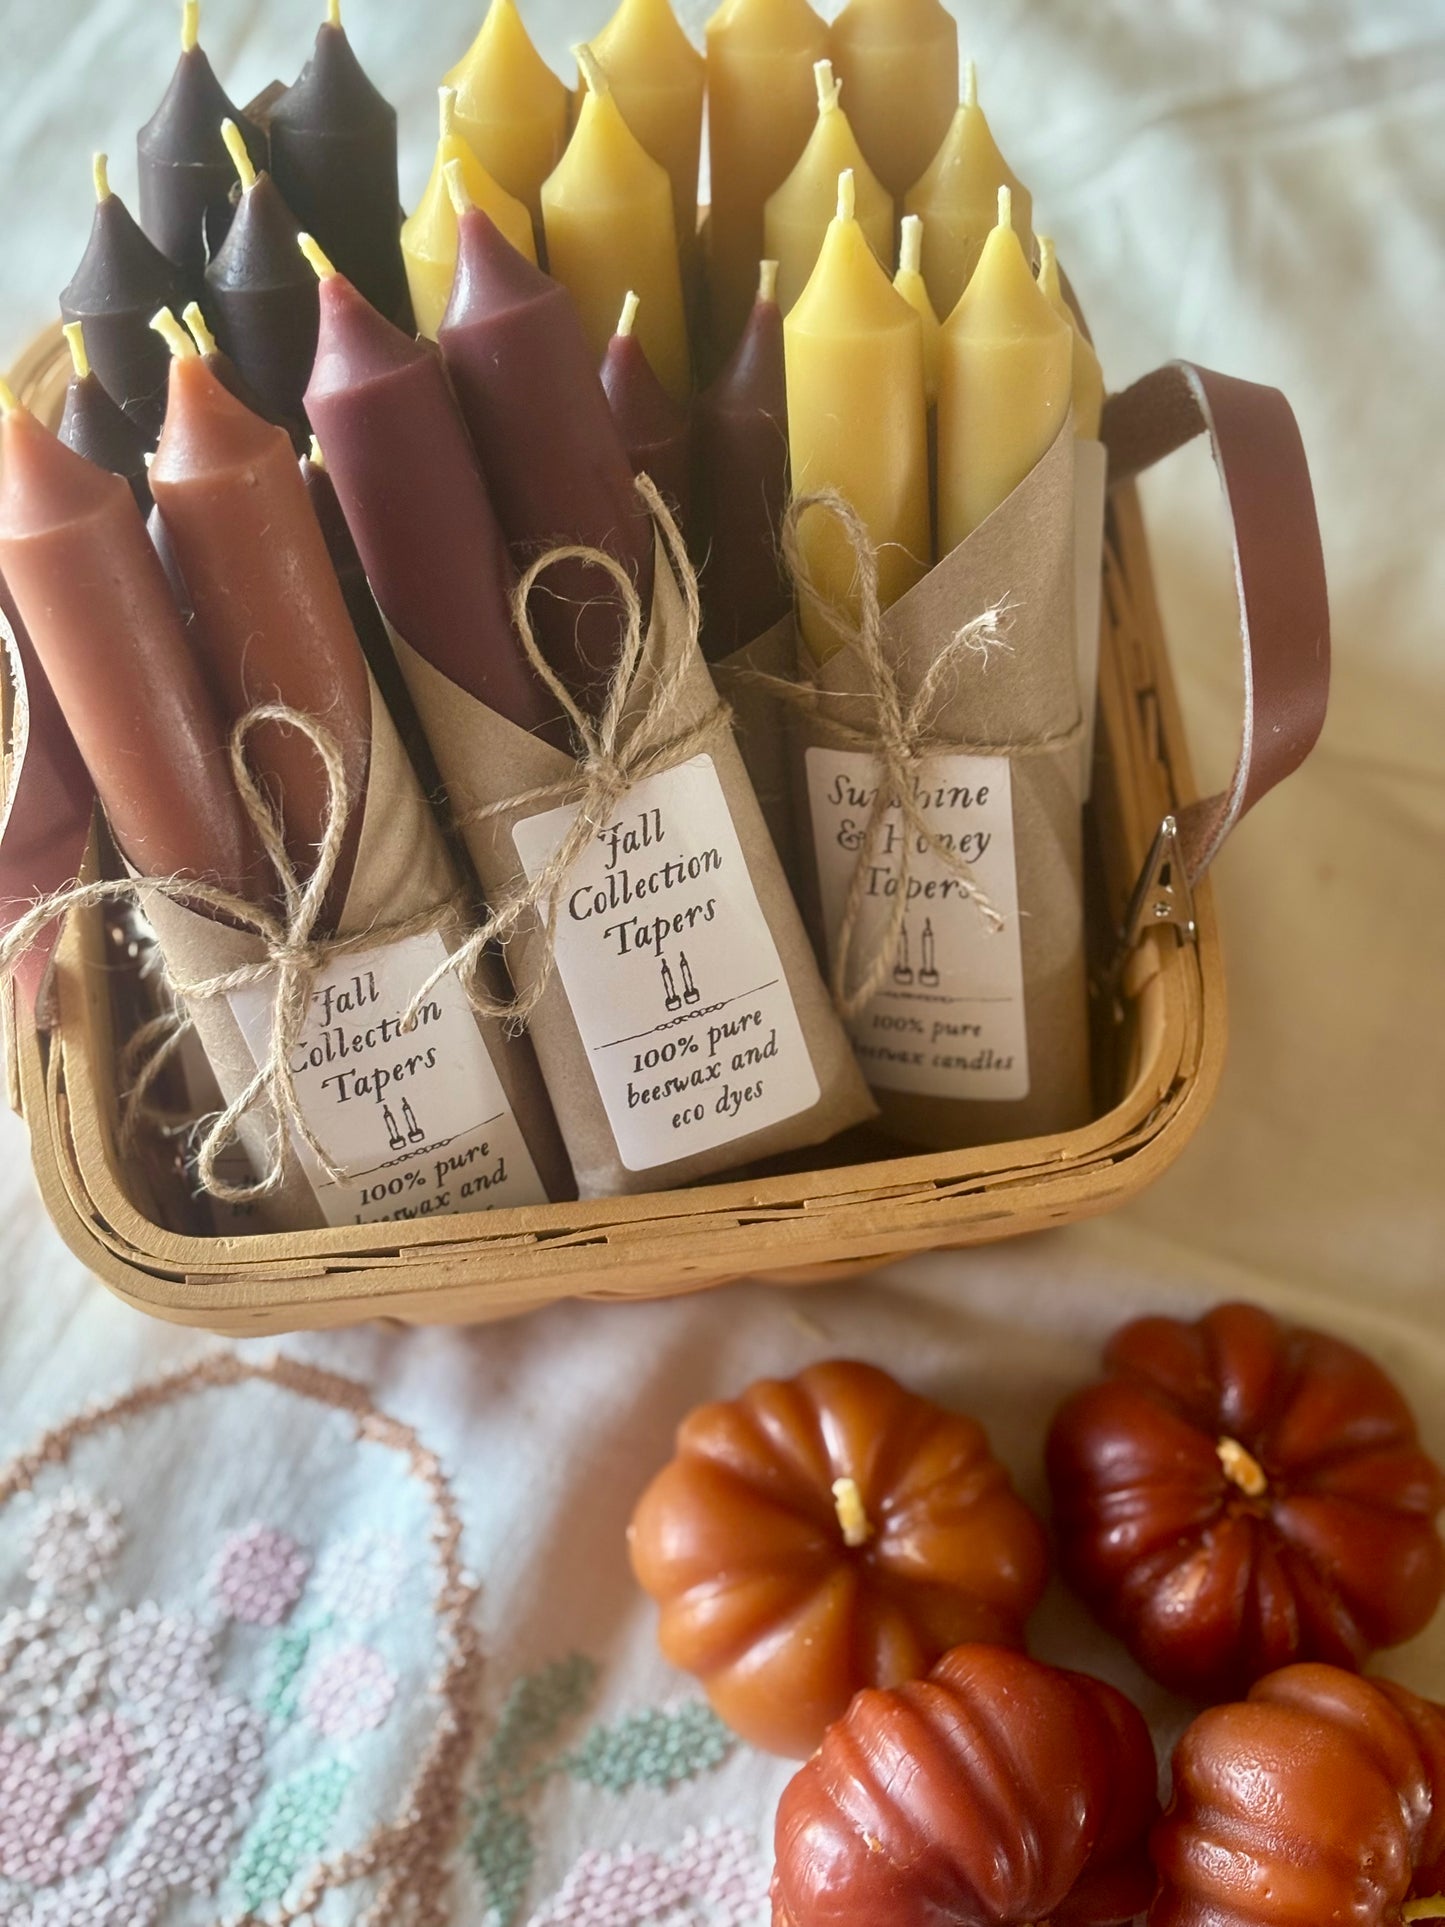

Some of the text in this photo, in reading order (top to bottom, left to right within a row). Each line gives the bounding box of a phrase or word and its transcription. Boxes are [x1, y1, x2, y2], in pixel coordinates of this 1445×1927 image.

[827, 774, 989, 809] Sushine
[598, 808, 665, 869] Fall
[837, 819, 991, 864] & Honey
[568, 847, 722, 921] Collection
[604, 897, 717, 957] Tapers
[312, 971, 380, 1028] Fall
[632, 1009, 763, 1073] 100% pure
[872, 1014, 981, 1043] 100% pure
[321, 1047, 437, 1104] Tapers
[627, 1029, 778, 1108] beeswax and
[932, 1048, 1014, 1070] candles
[671, 1078, 764, 1129] eco dyes
[360, 1142, 490, 1206] 100% pure
[460, 1157, 508, 1198] and
